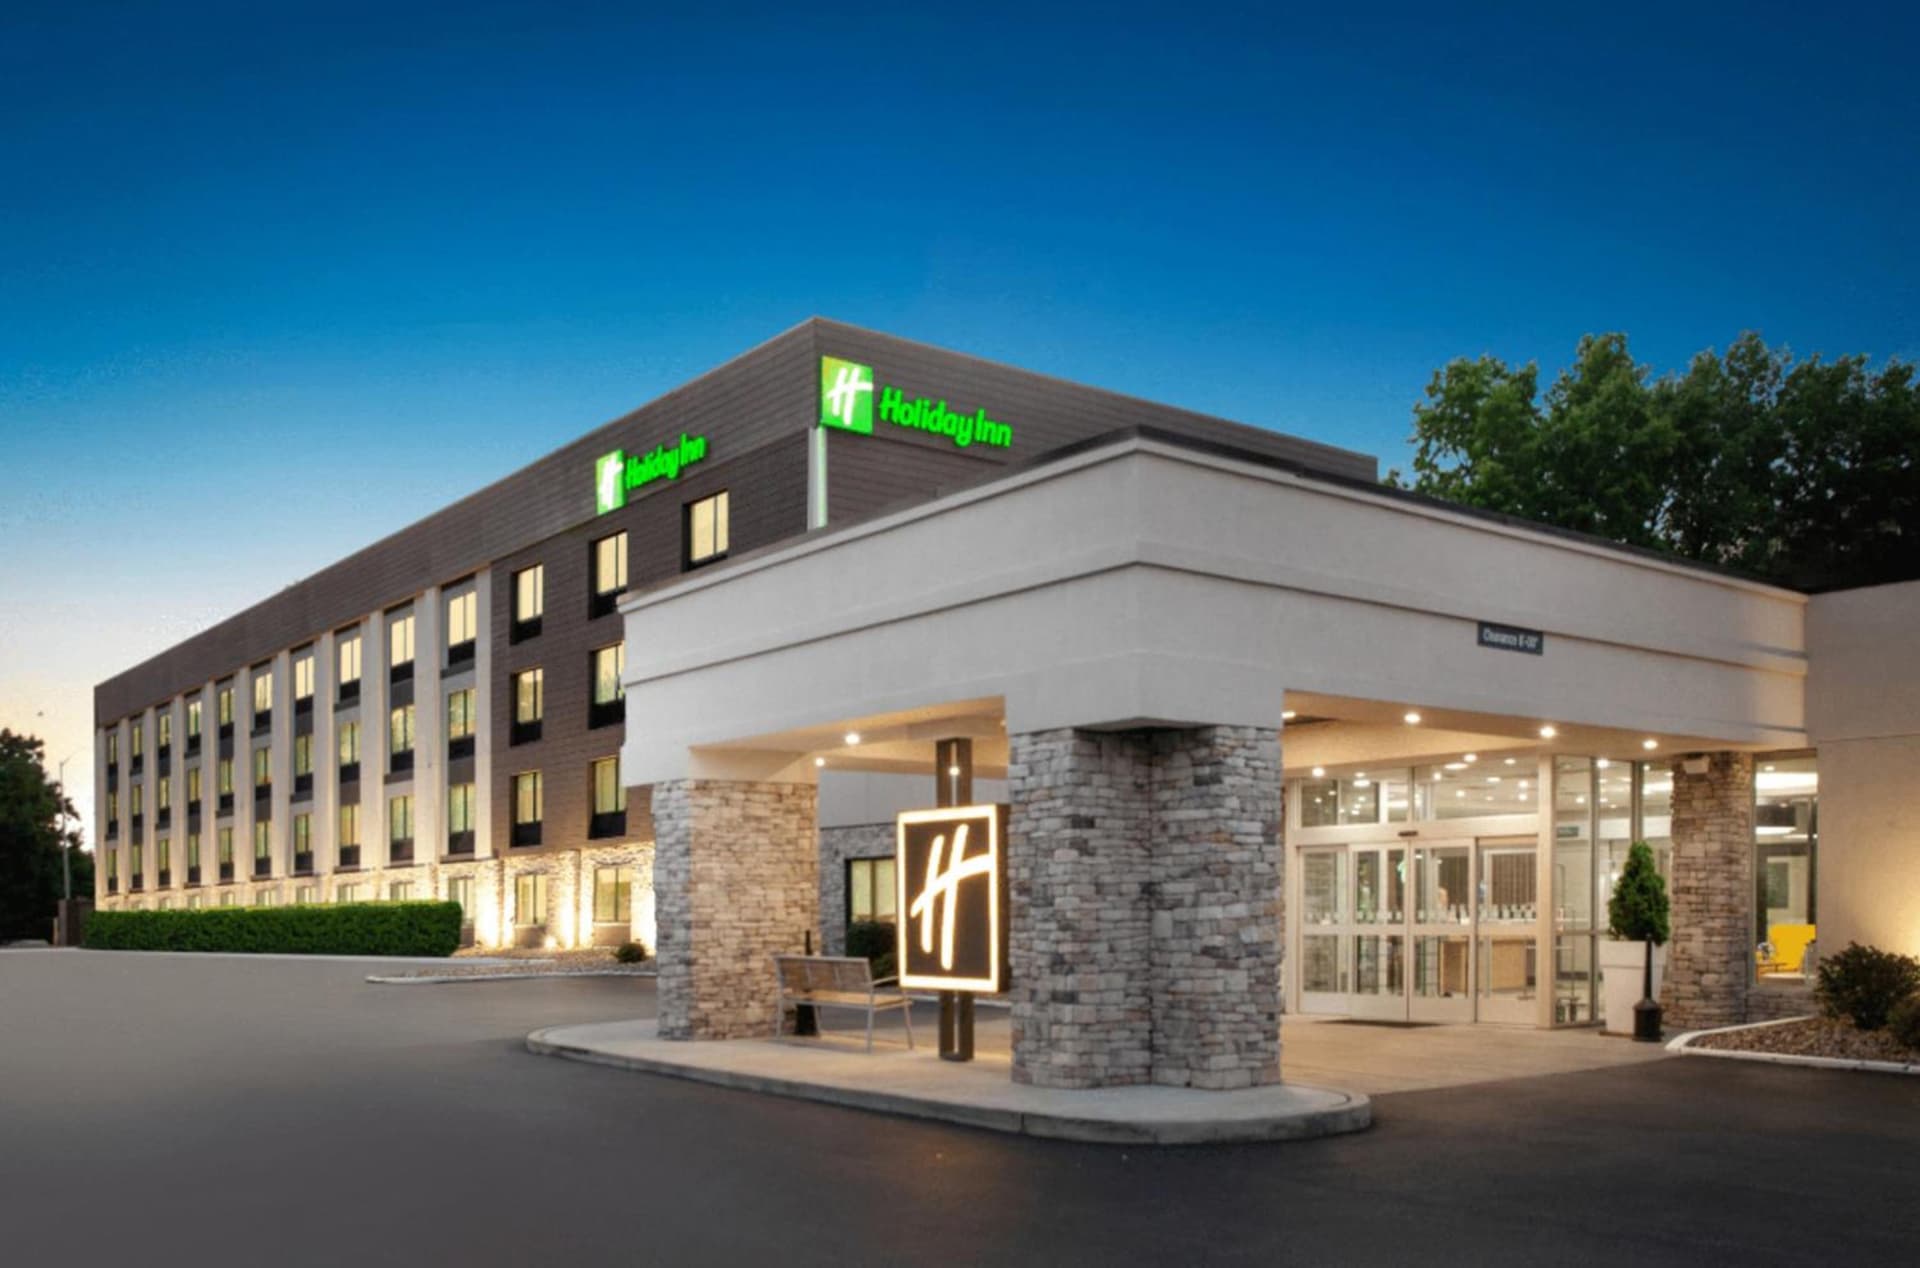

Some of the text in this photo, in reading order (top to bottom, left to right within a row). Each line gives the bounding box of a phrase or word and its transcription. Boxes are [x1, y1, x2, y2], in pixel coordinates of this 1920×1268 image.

[879, 386, 1012, 447] Holiday Inn
[625, 433, 705, 489] Holiday Inn
